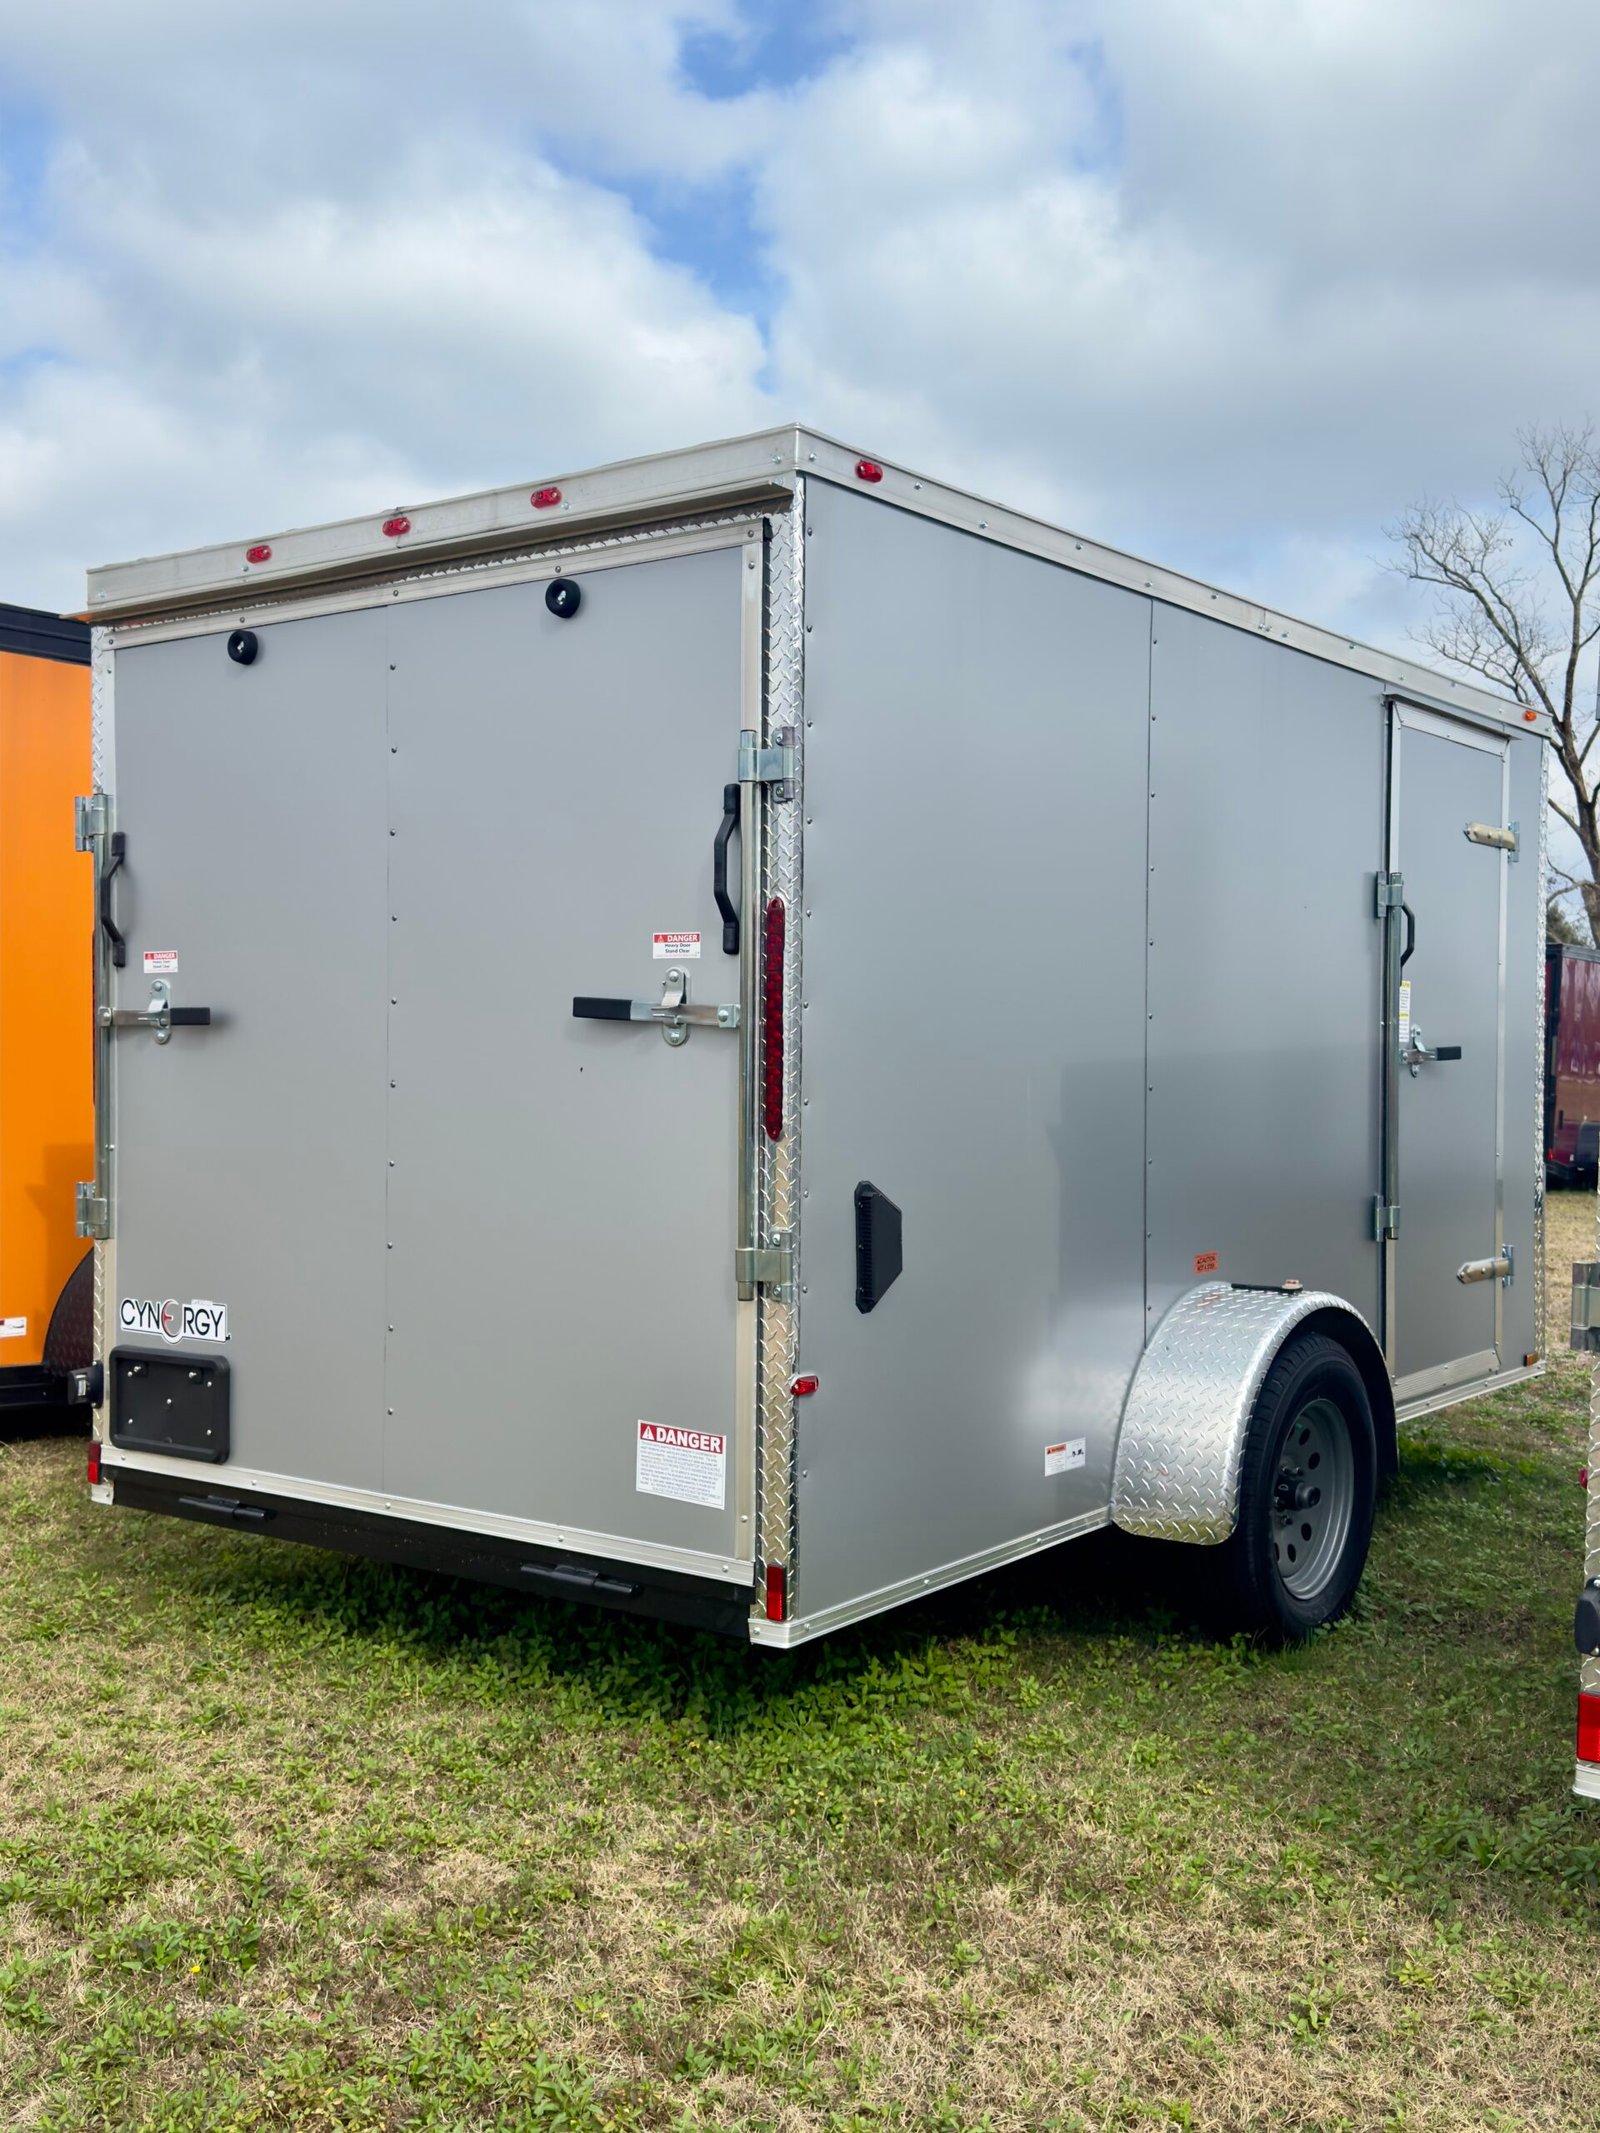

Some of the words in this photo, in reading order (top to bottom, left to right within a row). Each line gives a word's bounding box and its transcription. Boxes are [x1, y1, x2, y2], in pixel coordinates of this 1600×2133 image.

[667, 934, 698, 943] DANGER
[121, 1299, 224, 1337] CYNERGY
[656, 1427, 721, 1453] DANGER
